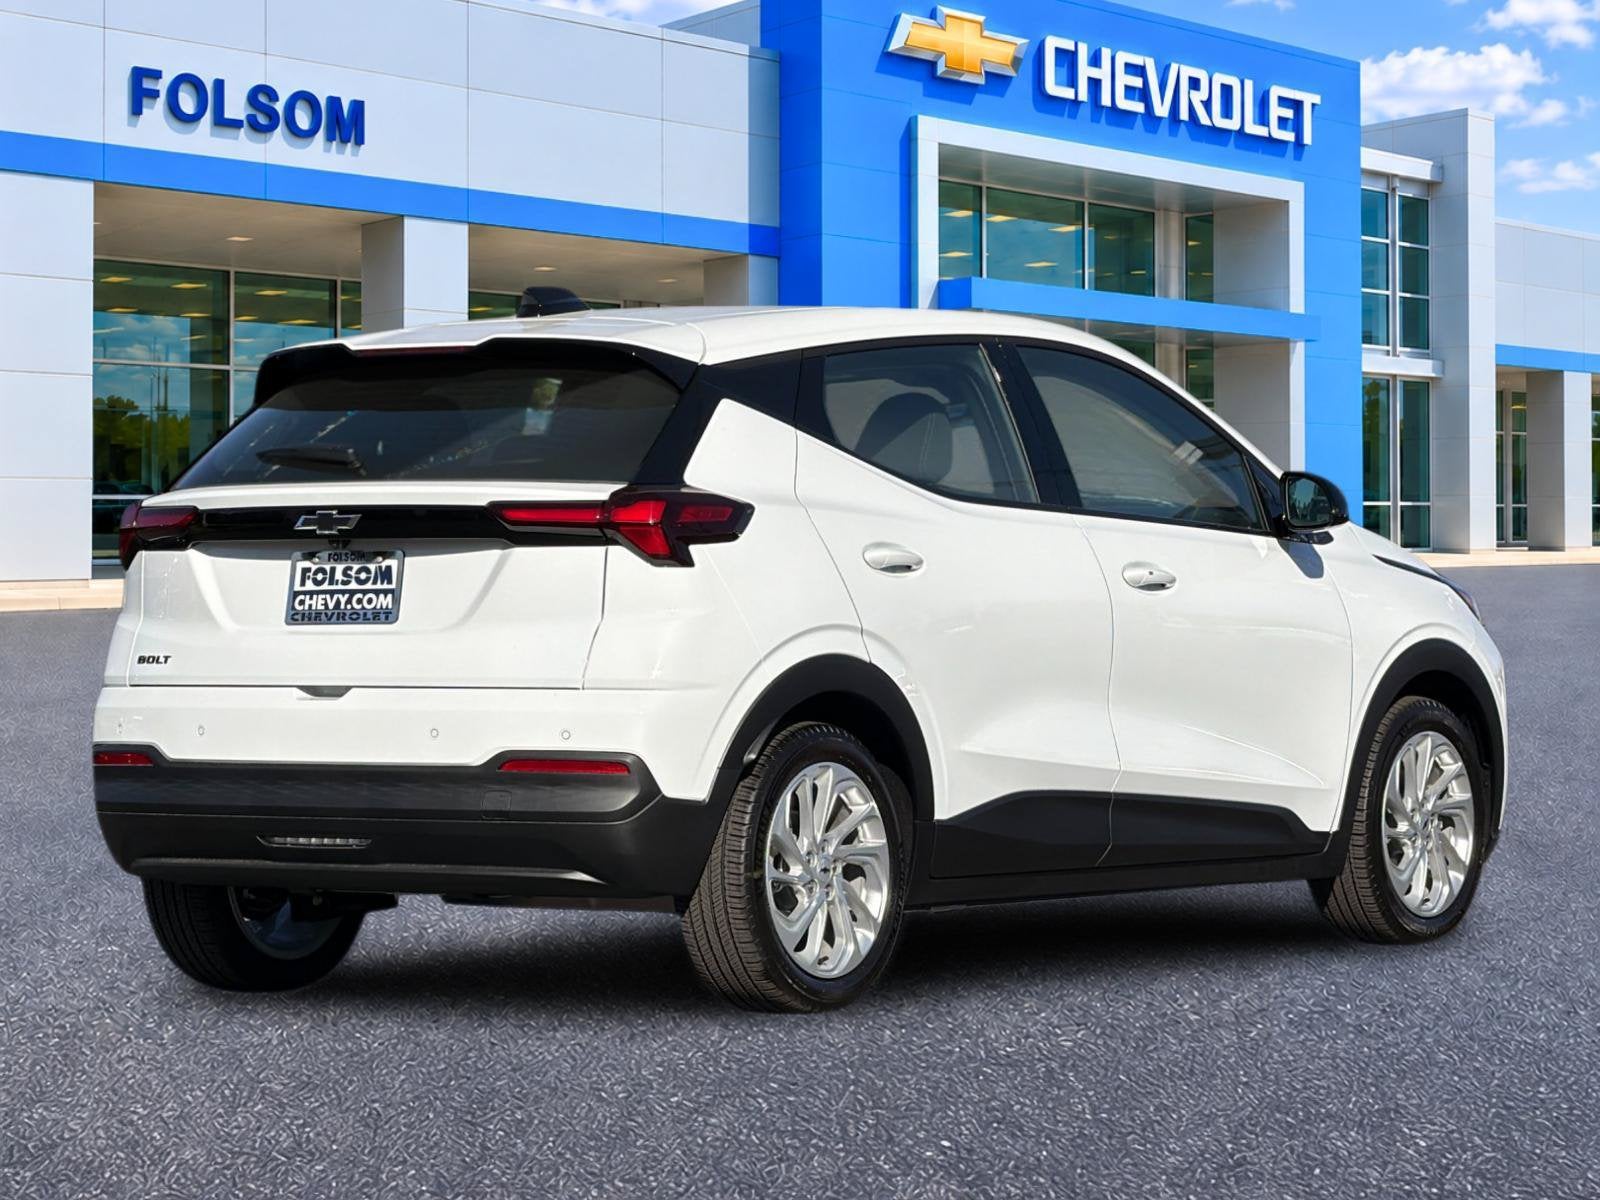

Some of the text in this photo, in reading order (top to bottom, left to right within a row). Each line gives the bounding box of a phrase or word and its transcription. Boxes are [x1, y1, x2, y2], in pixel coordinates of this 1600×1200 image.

[1043, 35, 1321, 146] CHEVROLET
[130, 65, 365, 146] FOLSOM
[327, 552, 367, 562] FOLSOM
[299, 565, 393, 587] FOLSOM
[294, 593, 393, 611] CHEVY.COM
[290, 611, 392, 622] CHEVROLET
[137, 655, 172, 665] BOLT
